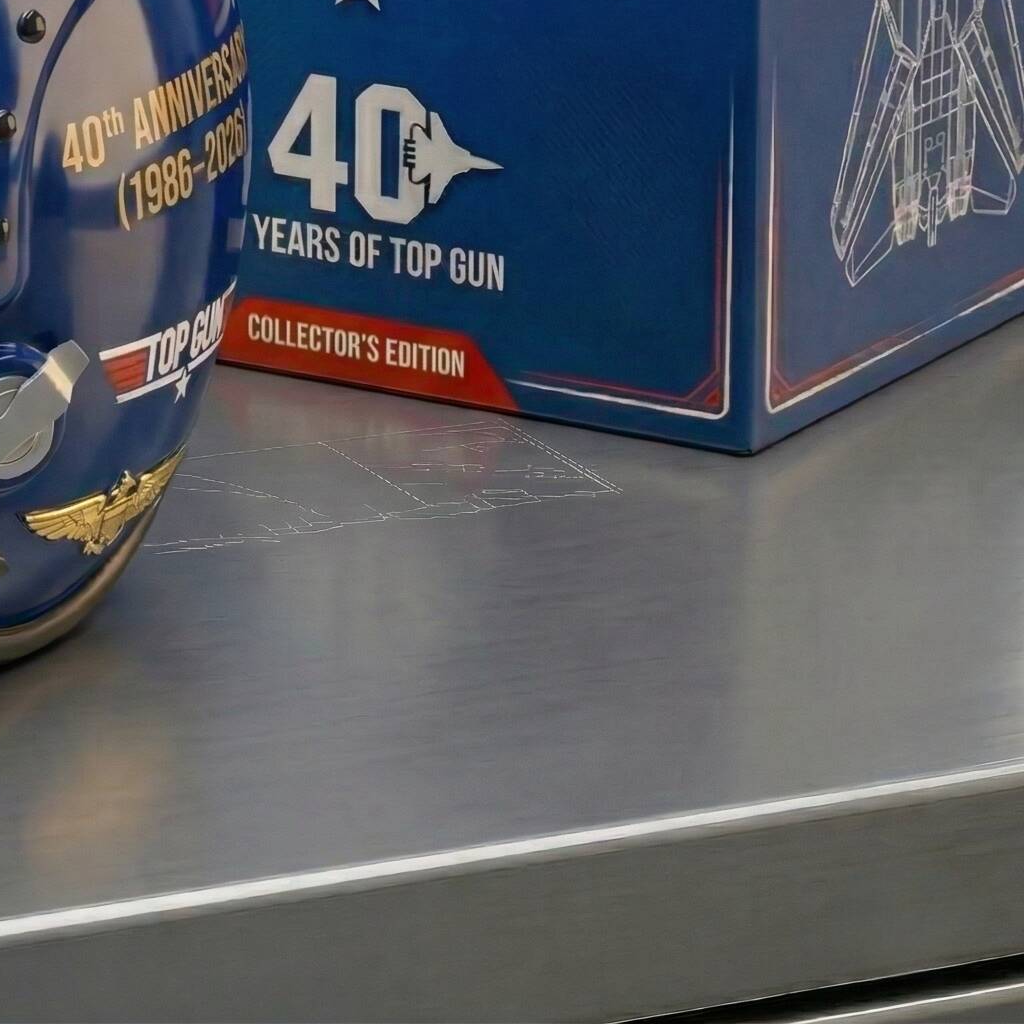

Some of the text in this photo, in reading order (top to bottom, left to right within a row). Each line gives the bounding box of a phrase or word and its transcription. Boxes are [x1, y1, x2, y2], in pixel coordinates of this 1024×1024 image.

[62, 24, 248, 174] 40th ANNIVERSAR
[252, 214, 504, 291] YEARS OF TOP GUN
[144, 294, 225, 382] TOP GUN
[247, 313, 465, 378] COLLECTOR'S EDITION
